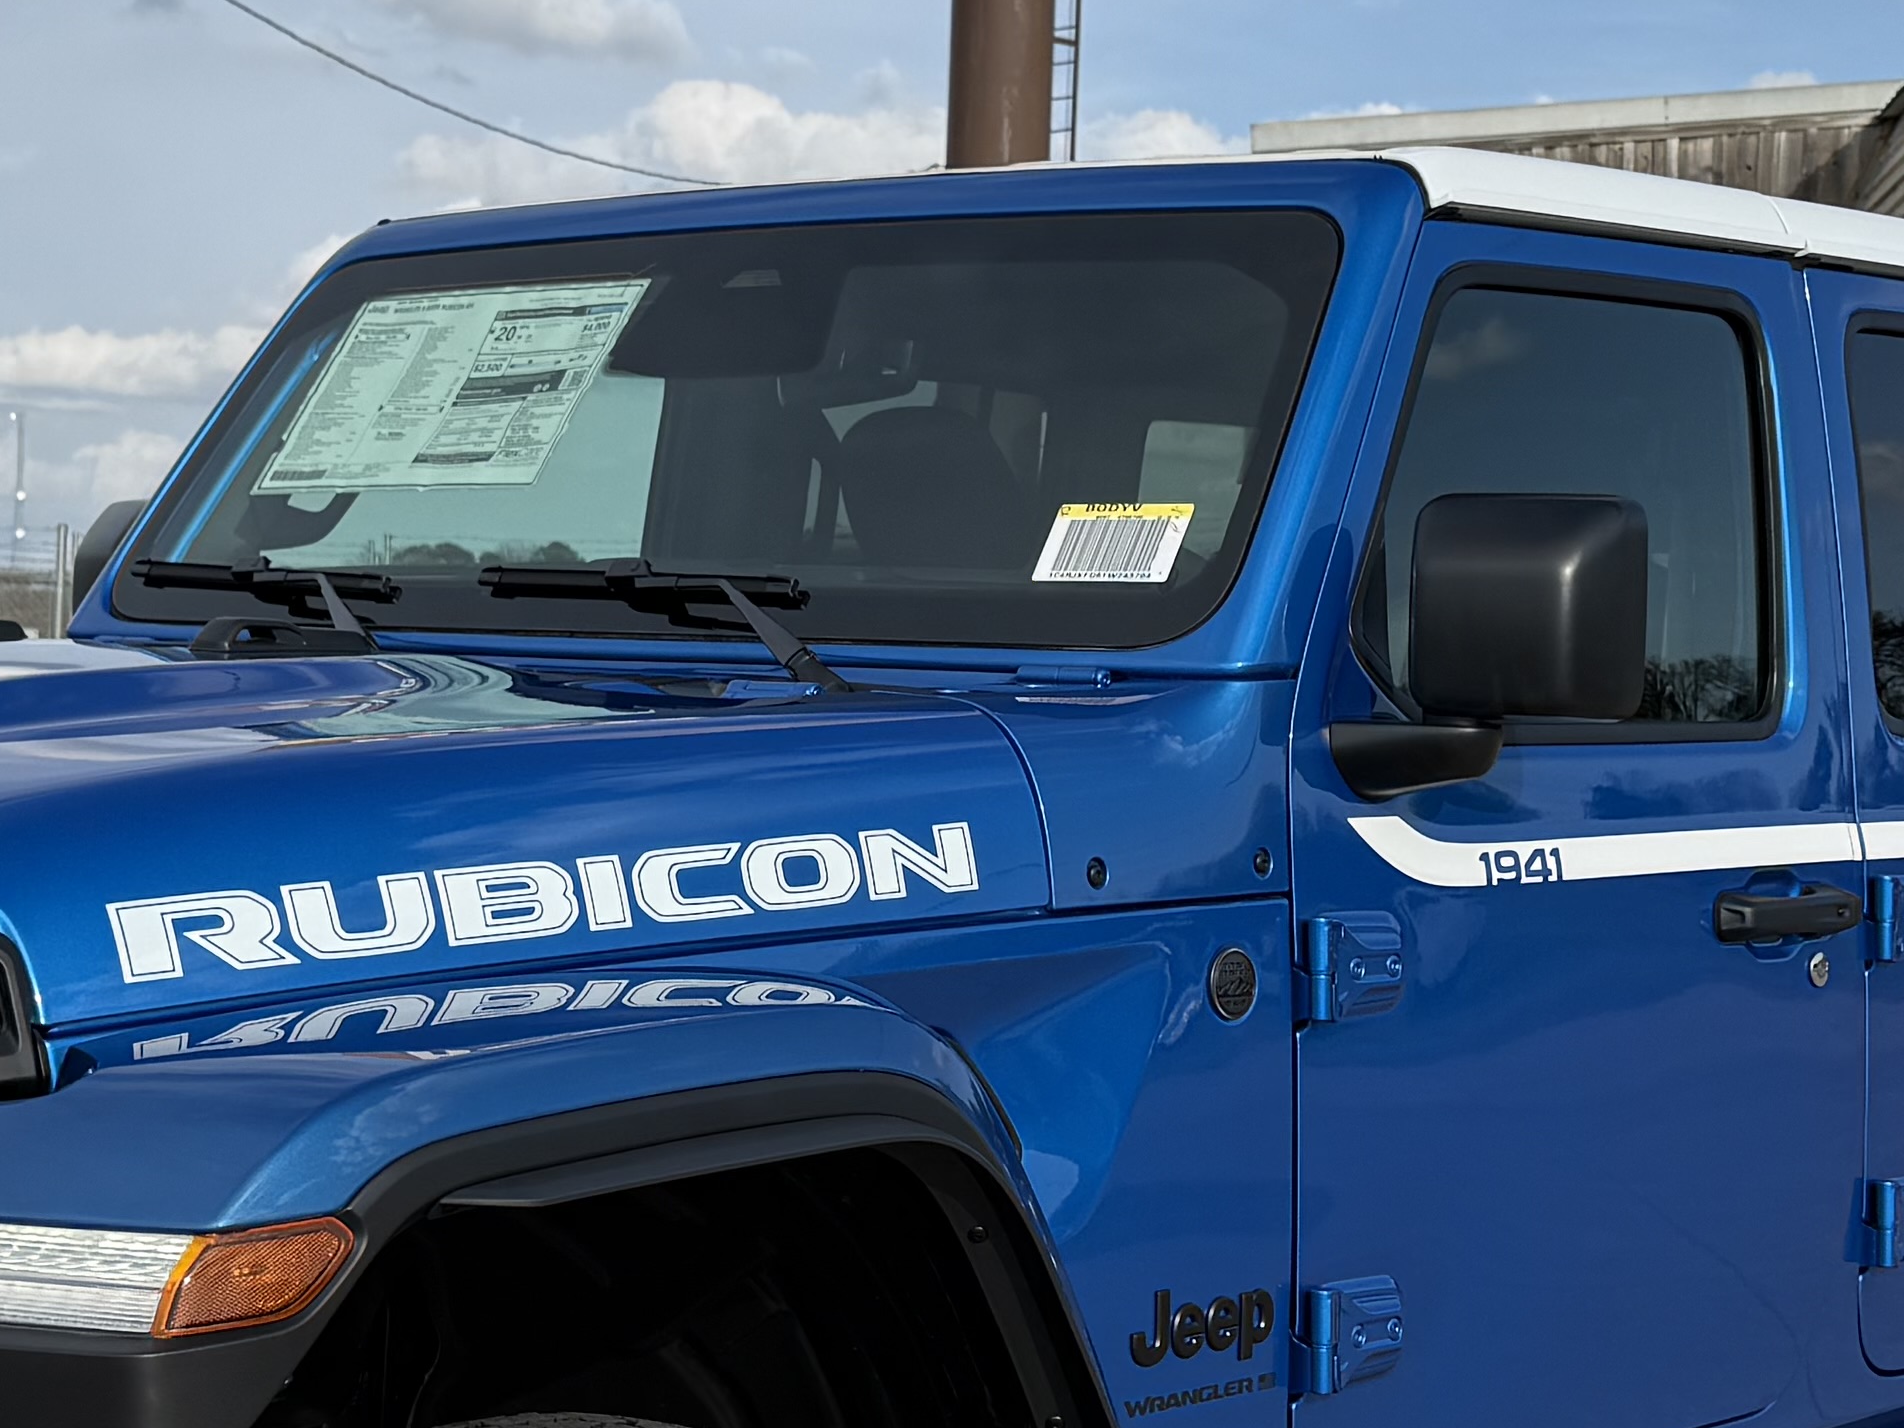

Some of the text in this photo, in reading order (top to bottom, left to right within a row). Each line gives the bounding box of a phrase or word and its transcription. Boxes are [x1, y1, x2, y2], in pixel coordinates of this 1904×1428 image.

[494, 325, 517, 342] 20
[1478, 846, 1564, 887] 1941
[106, 822, 980, 984] RUBICON
[1129, 1288, 1275, 1368] Jeep
[1123, 1377, 1255, 1419] WRANGLER
